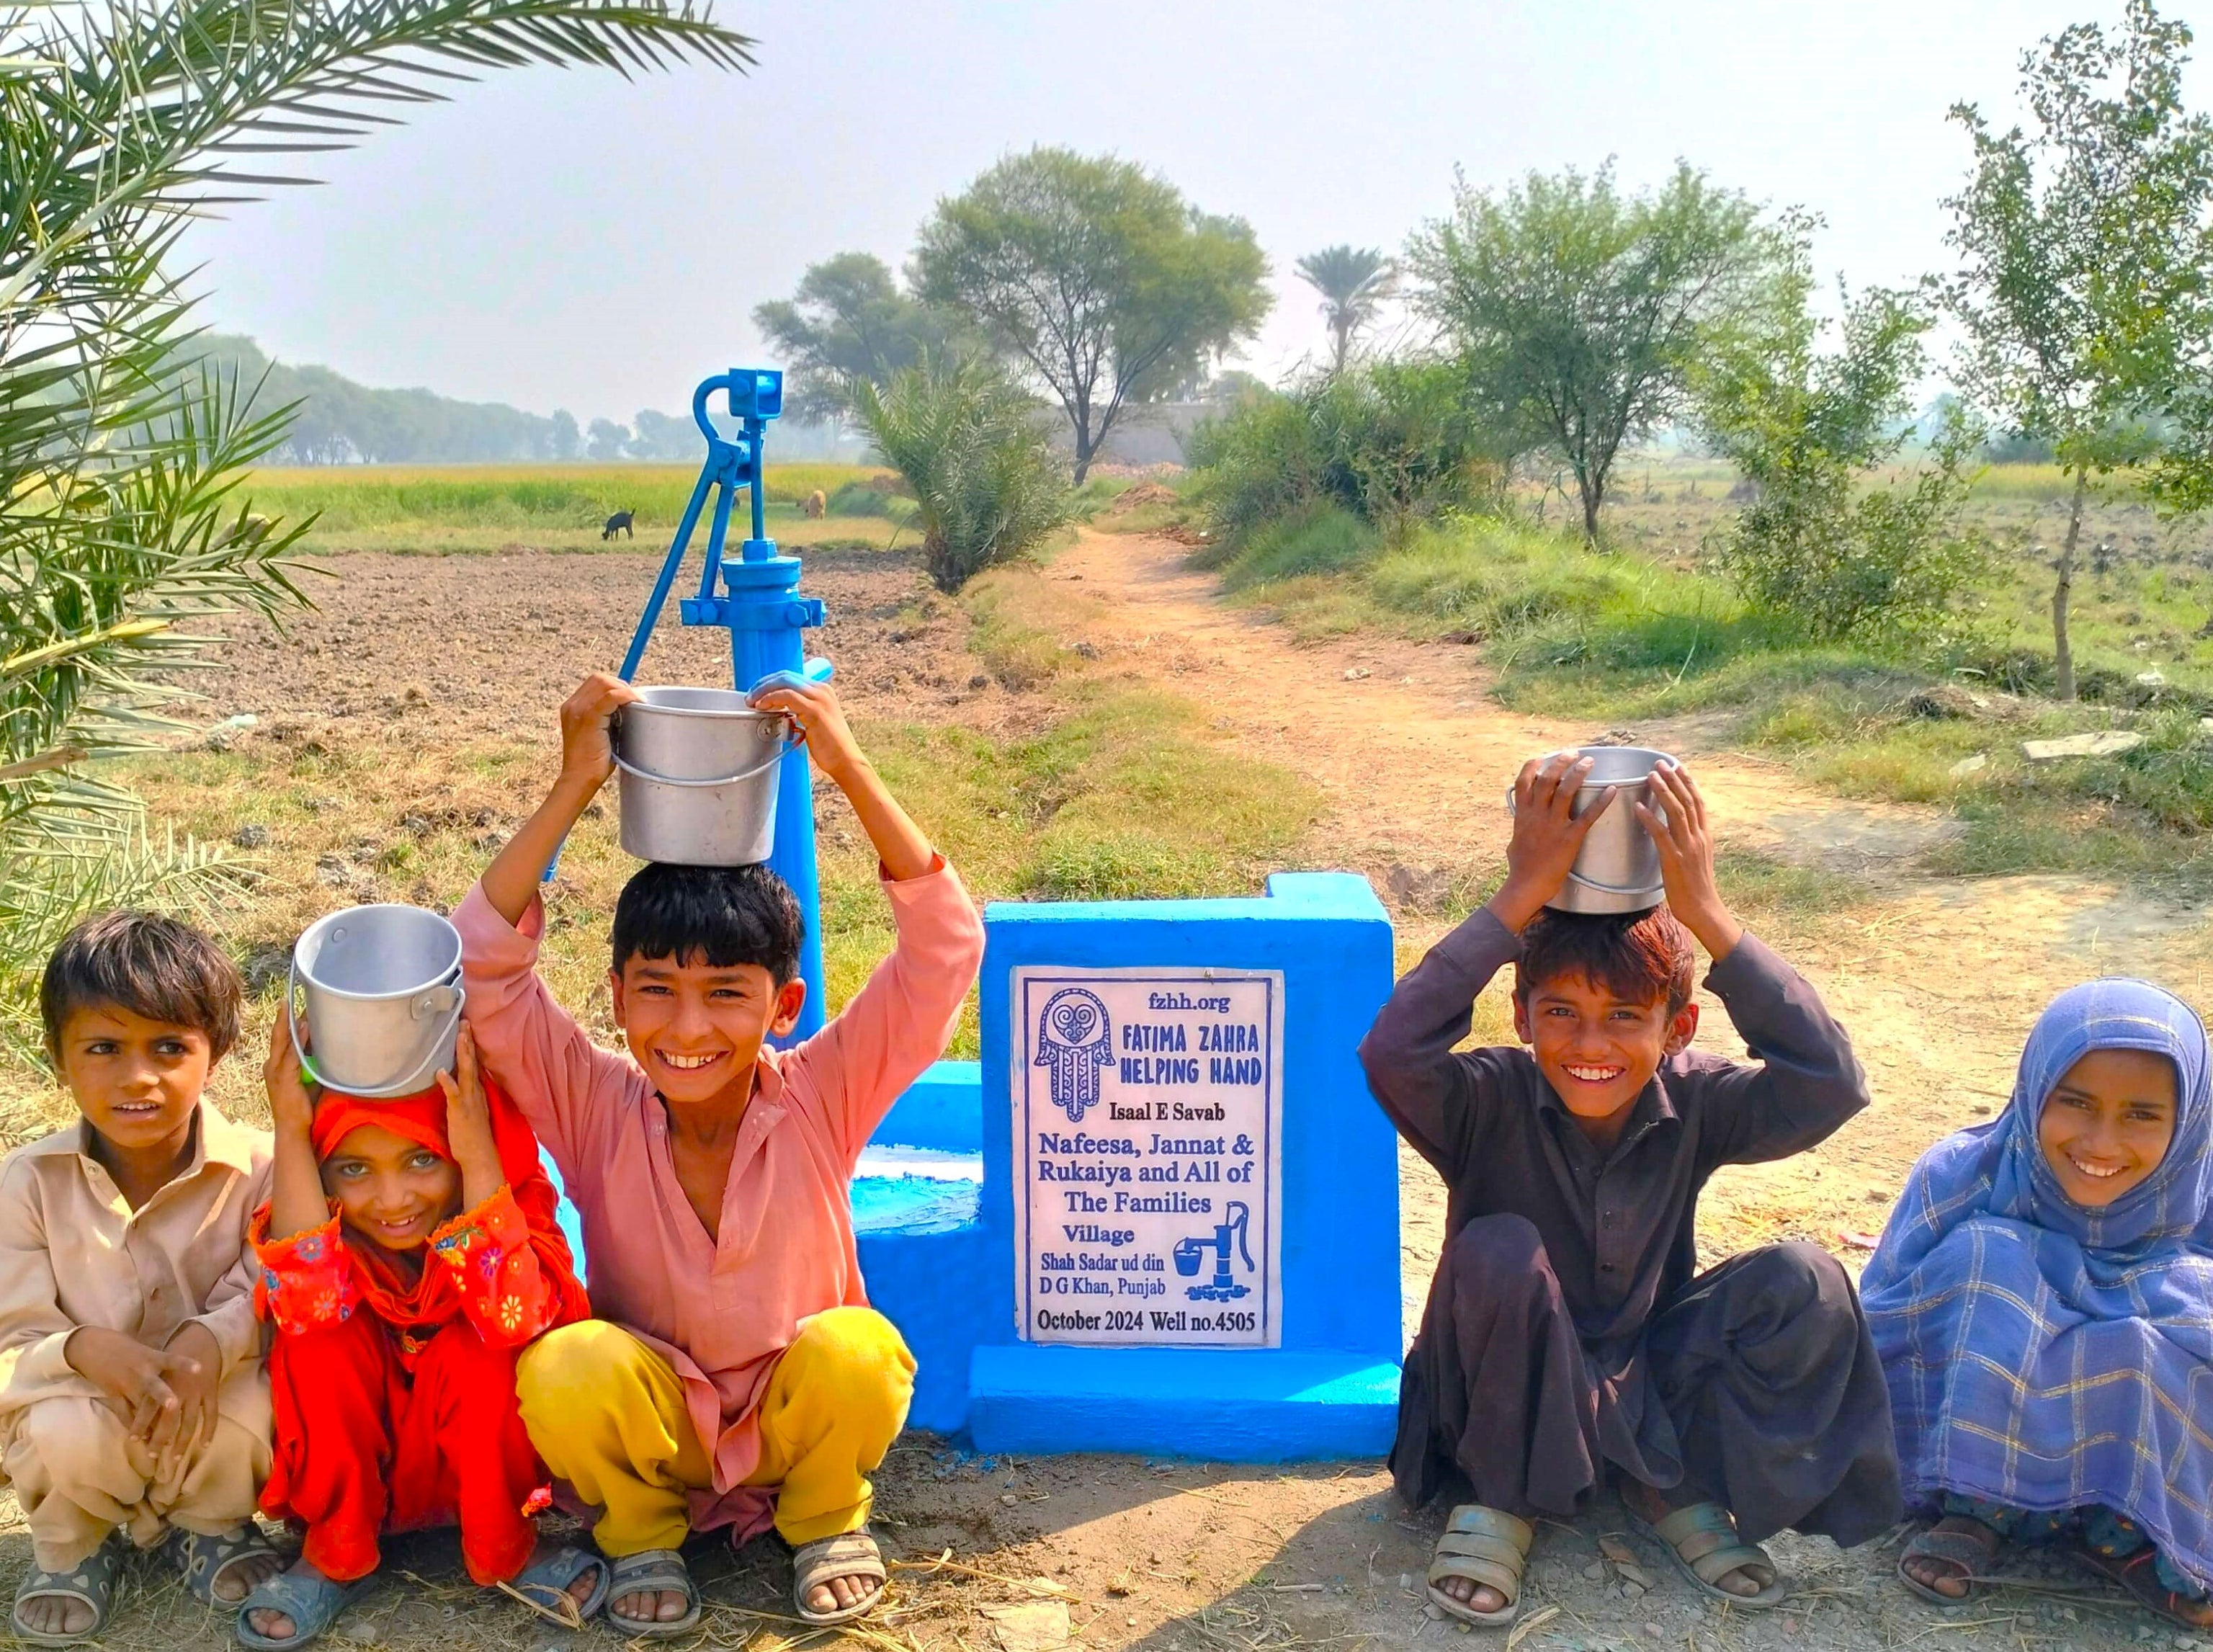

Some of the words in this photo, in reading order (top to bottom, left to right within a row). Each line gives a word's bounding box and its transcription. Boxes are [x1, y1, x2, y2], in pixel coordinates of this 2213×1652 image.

[1148, 993, 1230, 1013] fzhh.org
[1122, 1024, 1186, 1053] FATIMA
[1199, 1024, 1258, 1053] ZAHRA
[1120, 1058, 1199, 1084] HELPING
[1210, 1058, 1262, 1085] HAND
[1109, 1102, 1151, 1121] Isaal
[1155, 1103, 1168, 1120] E
[1173, 1103, 1225, 1121] Savab
[1038, 1133, 1141, 1158] Nafeesa,
[1148, 1134, 1225, 1155] Jannat
[1232, 1134, 1253, 1155] &
[1038, 1161, 1132, 1187] Rukaiya
[1139, 1161, 1179, 1182] and
[1184, 1161, 1220, 1182] All
[1227, 1161, 1254, 1182] of
[1064, 1192, 1107, 1213] The
[1114, 1193, 1211, 1213] Families
[1063, 1225, 1135, 1246] Village
[1041, 1253, 1075, 1271] Shah
[1079, 1254, 1118, 1271] Sadar
[1122, 1254, 1139, 1272] ud
[1143, 1254, 1164, 1272] din
[1040, 1278, 1052, 1294] D
[1056, 1278, 1069, 1294] G
[1073, 1278, 1114, 1297] Khan,
[1118, 1278, 1166, 1298] Punjab
[1037, 1309, 1101, 1331] October
[1105, 1311, 1143, 1331] 2024
[1149, 1311, 1186, 1331] Well
[1191, 1312, 1255, 1331] no.4505
